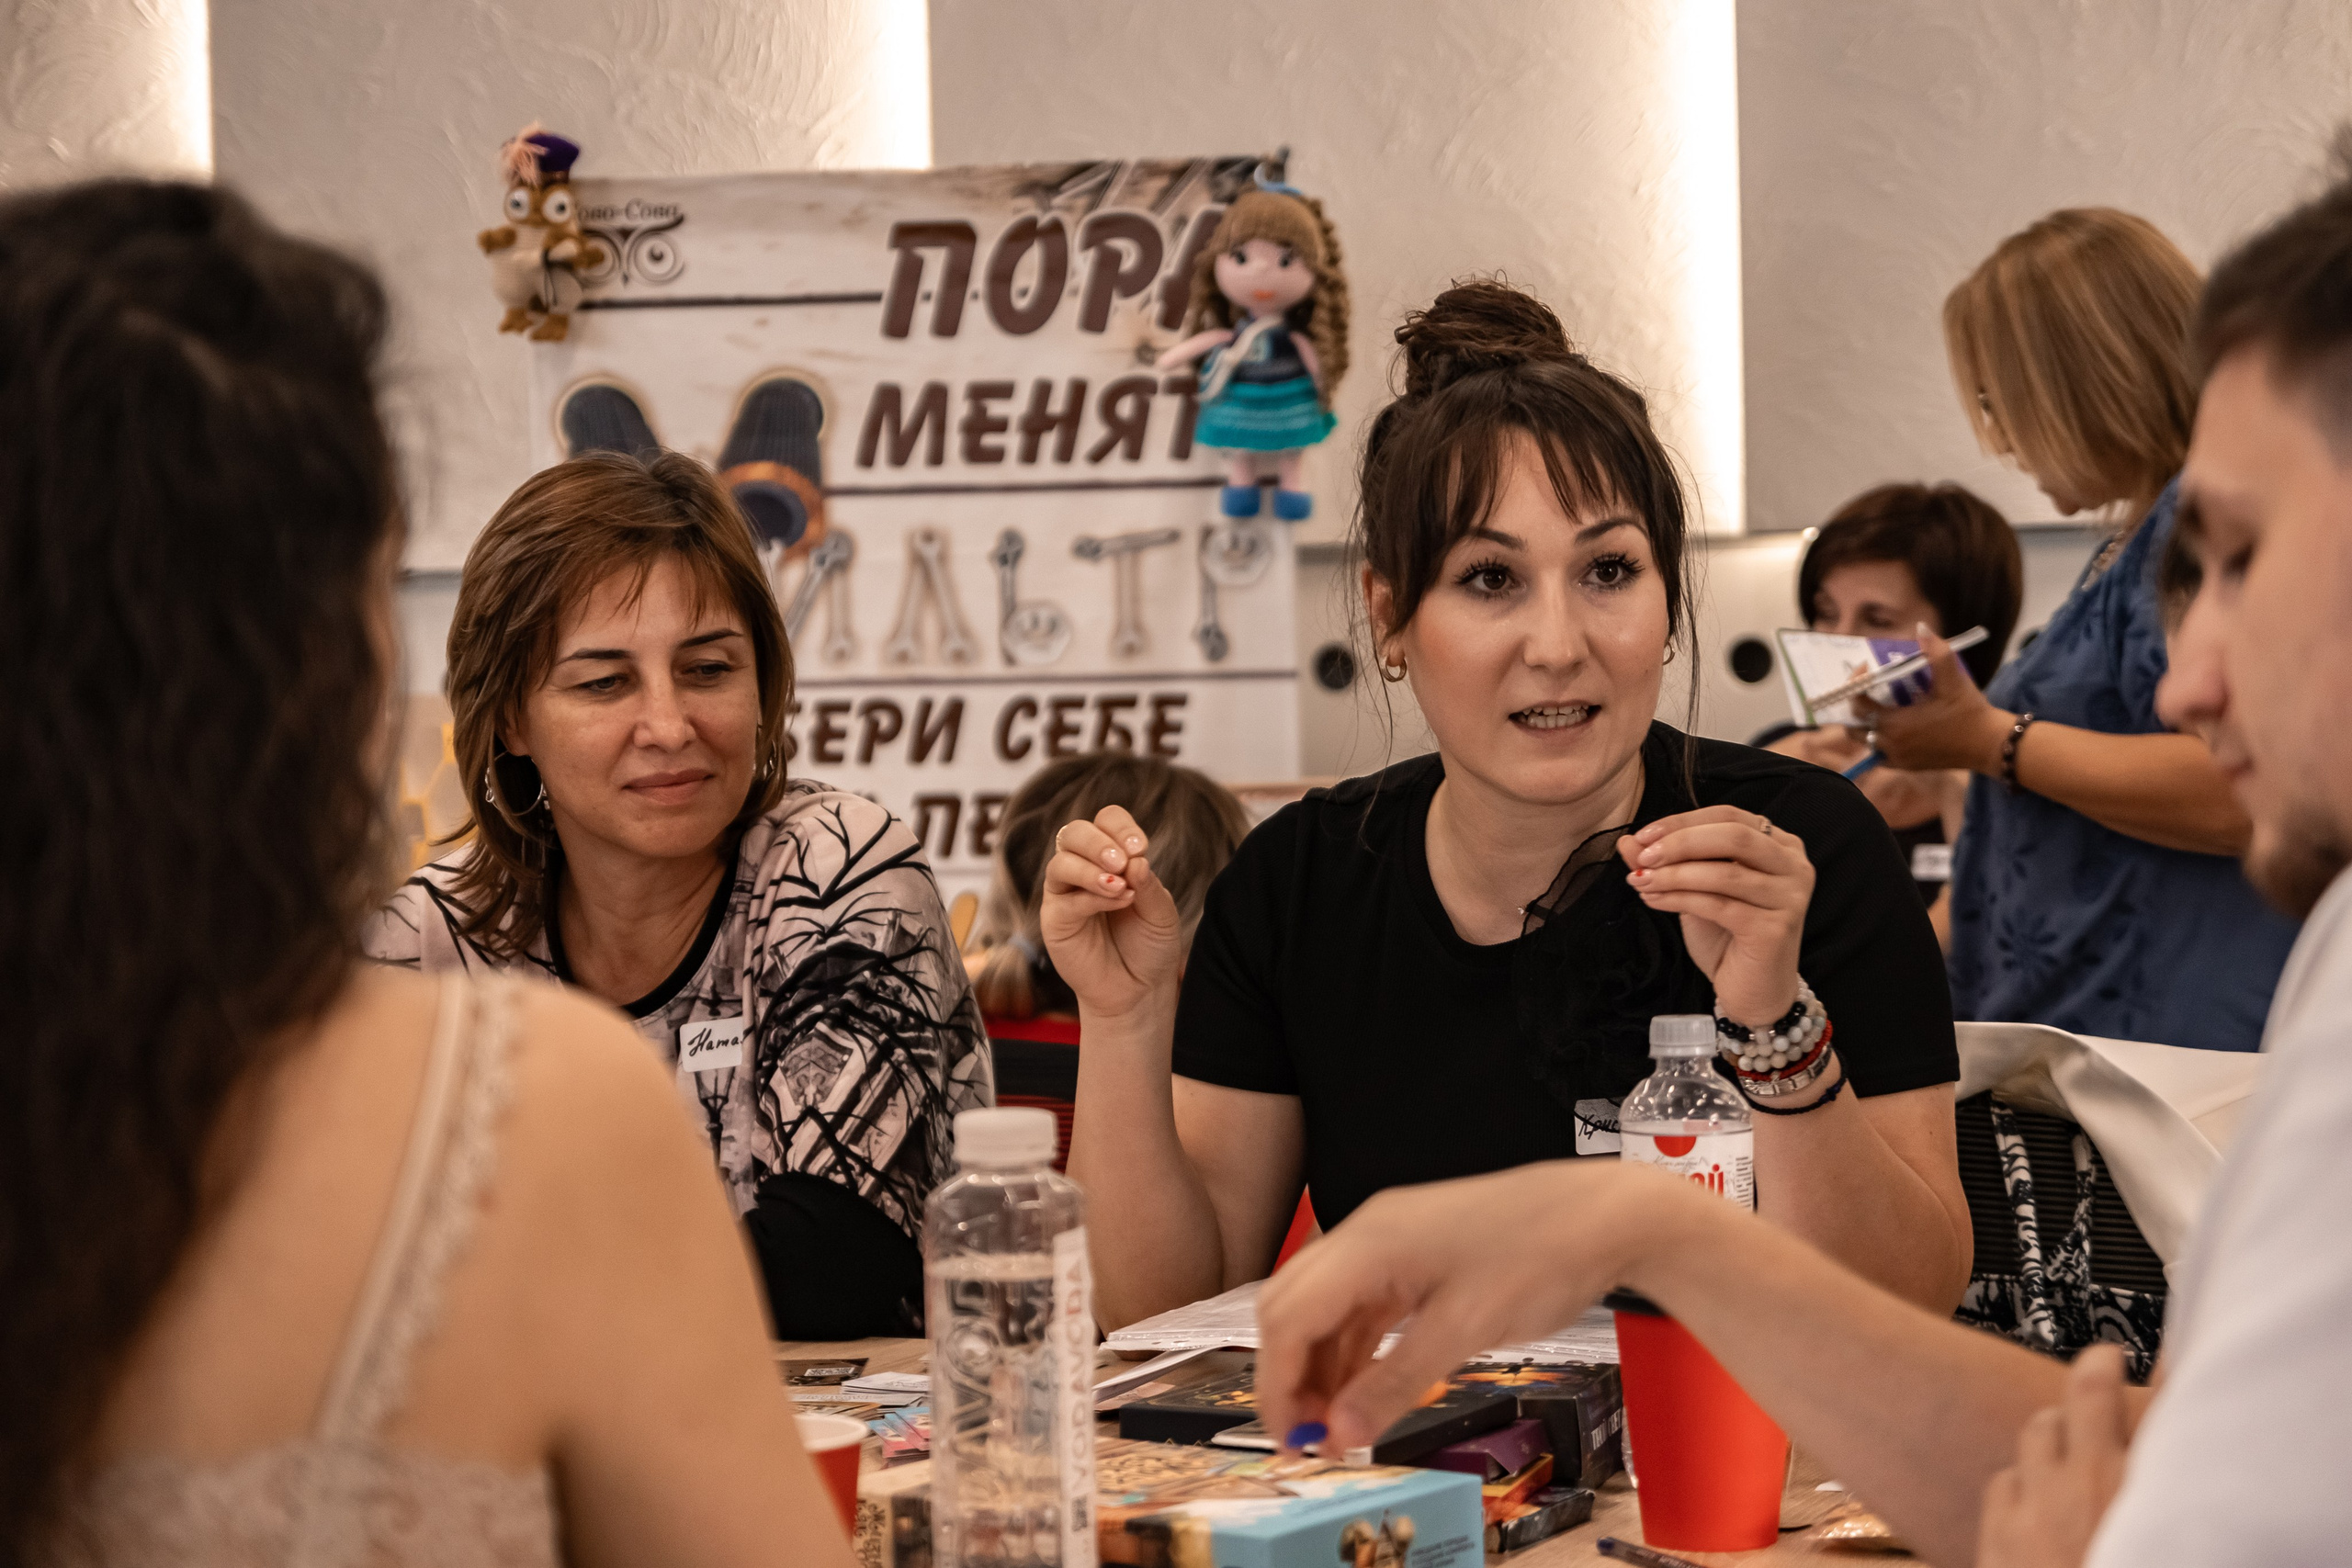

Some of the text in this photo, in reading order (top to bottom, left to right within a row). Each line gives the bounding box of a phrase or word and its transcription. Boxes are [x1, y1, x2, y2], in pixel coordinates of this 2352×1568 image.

[855, 377, 1200, 468] МЕНЯТ
[786, 693, 1189, 764] ЕРИ СЕБЕ
[912, 792, 1012, 859] ПЕ
[687, 1028, 740, 1057] Ната
[1578, 1114, 1619, 1140] Крис
